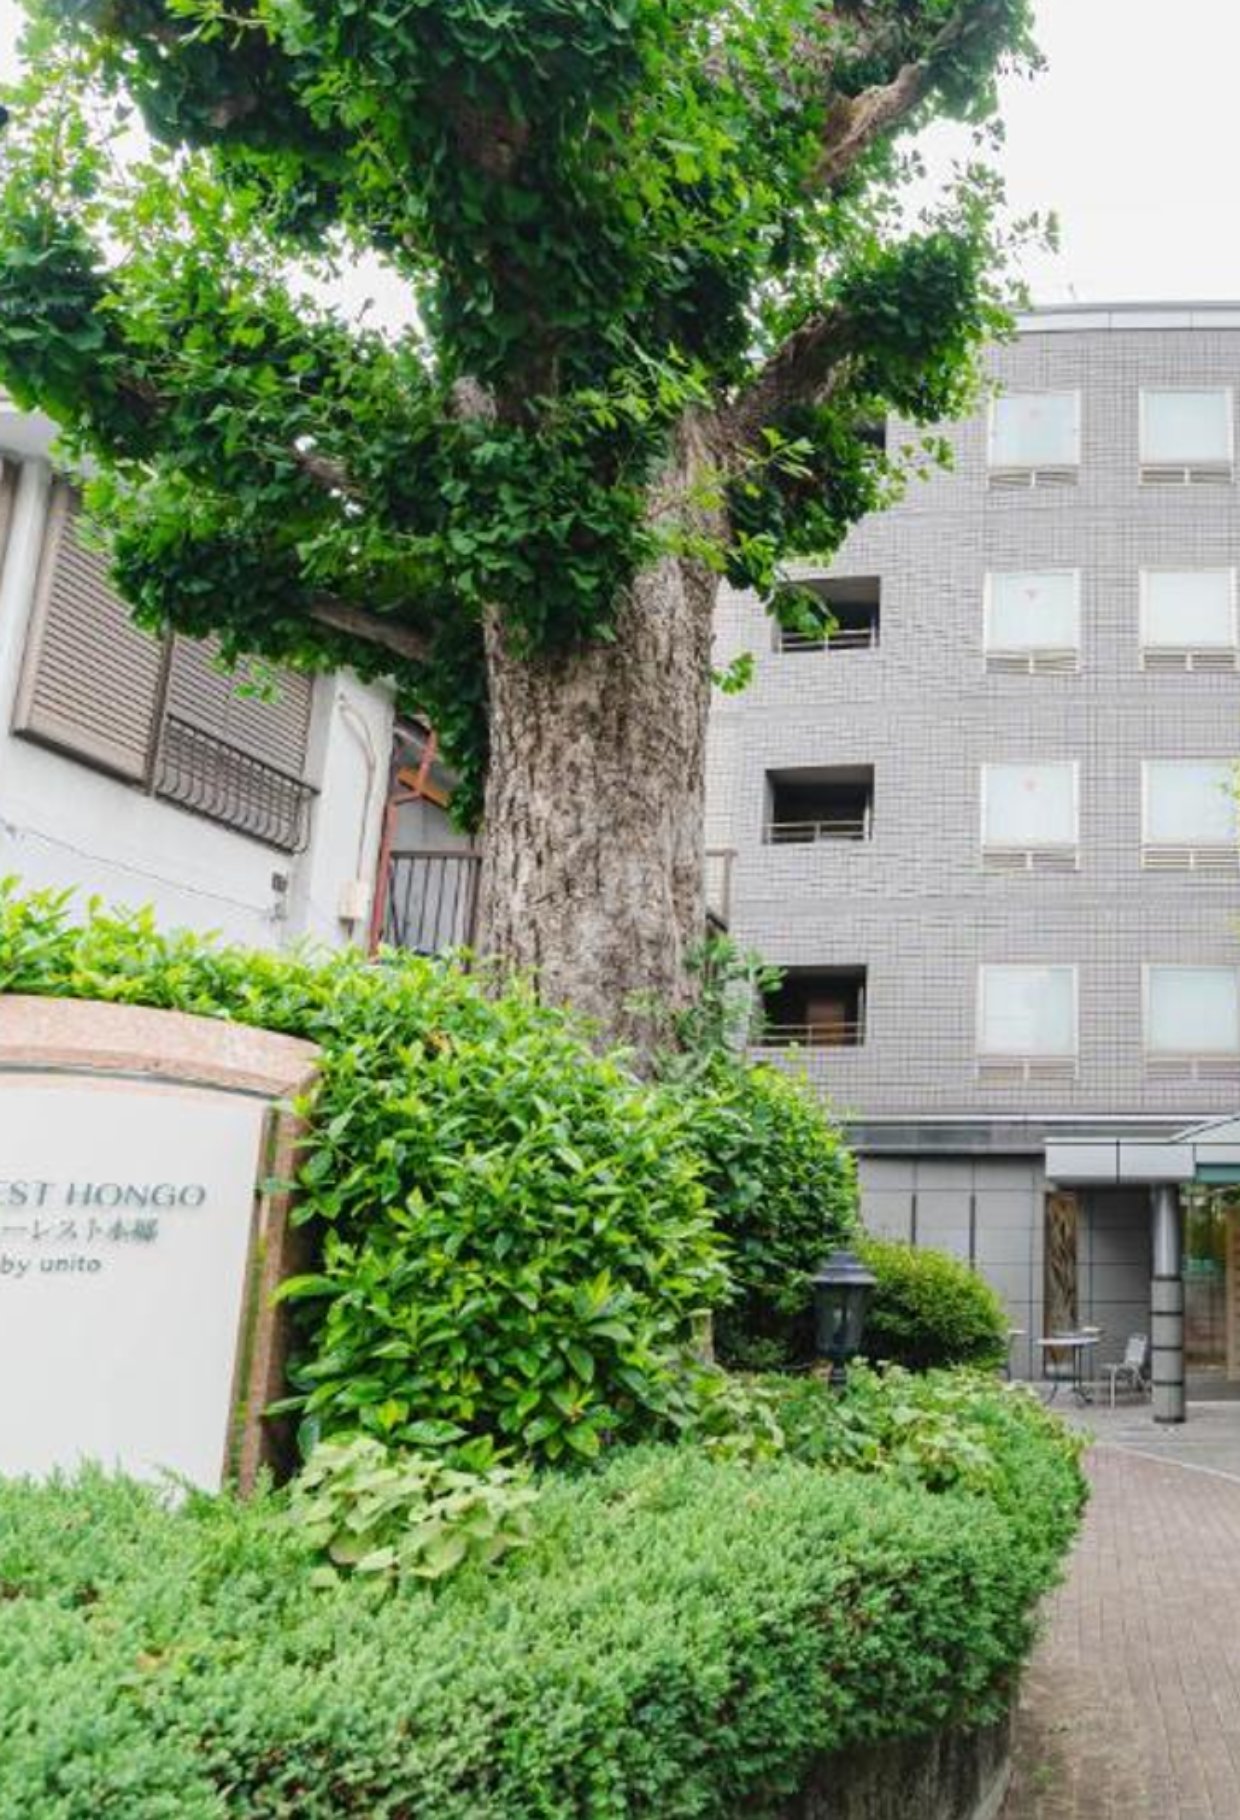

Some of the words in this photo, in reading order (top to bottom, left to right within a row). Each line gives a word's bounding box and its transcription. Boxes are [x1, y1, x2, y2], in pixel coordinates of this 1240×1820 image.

[66, 1180, 206, 1208] HONGO
[0, 1254, 32, 1279] by
[39, 1255, 103, 1273] unito
